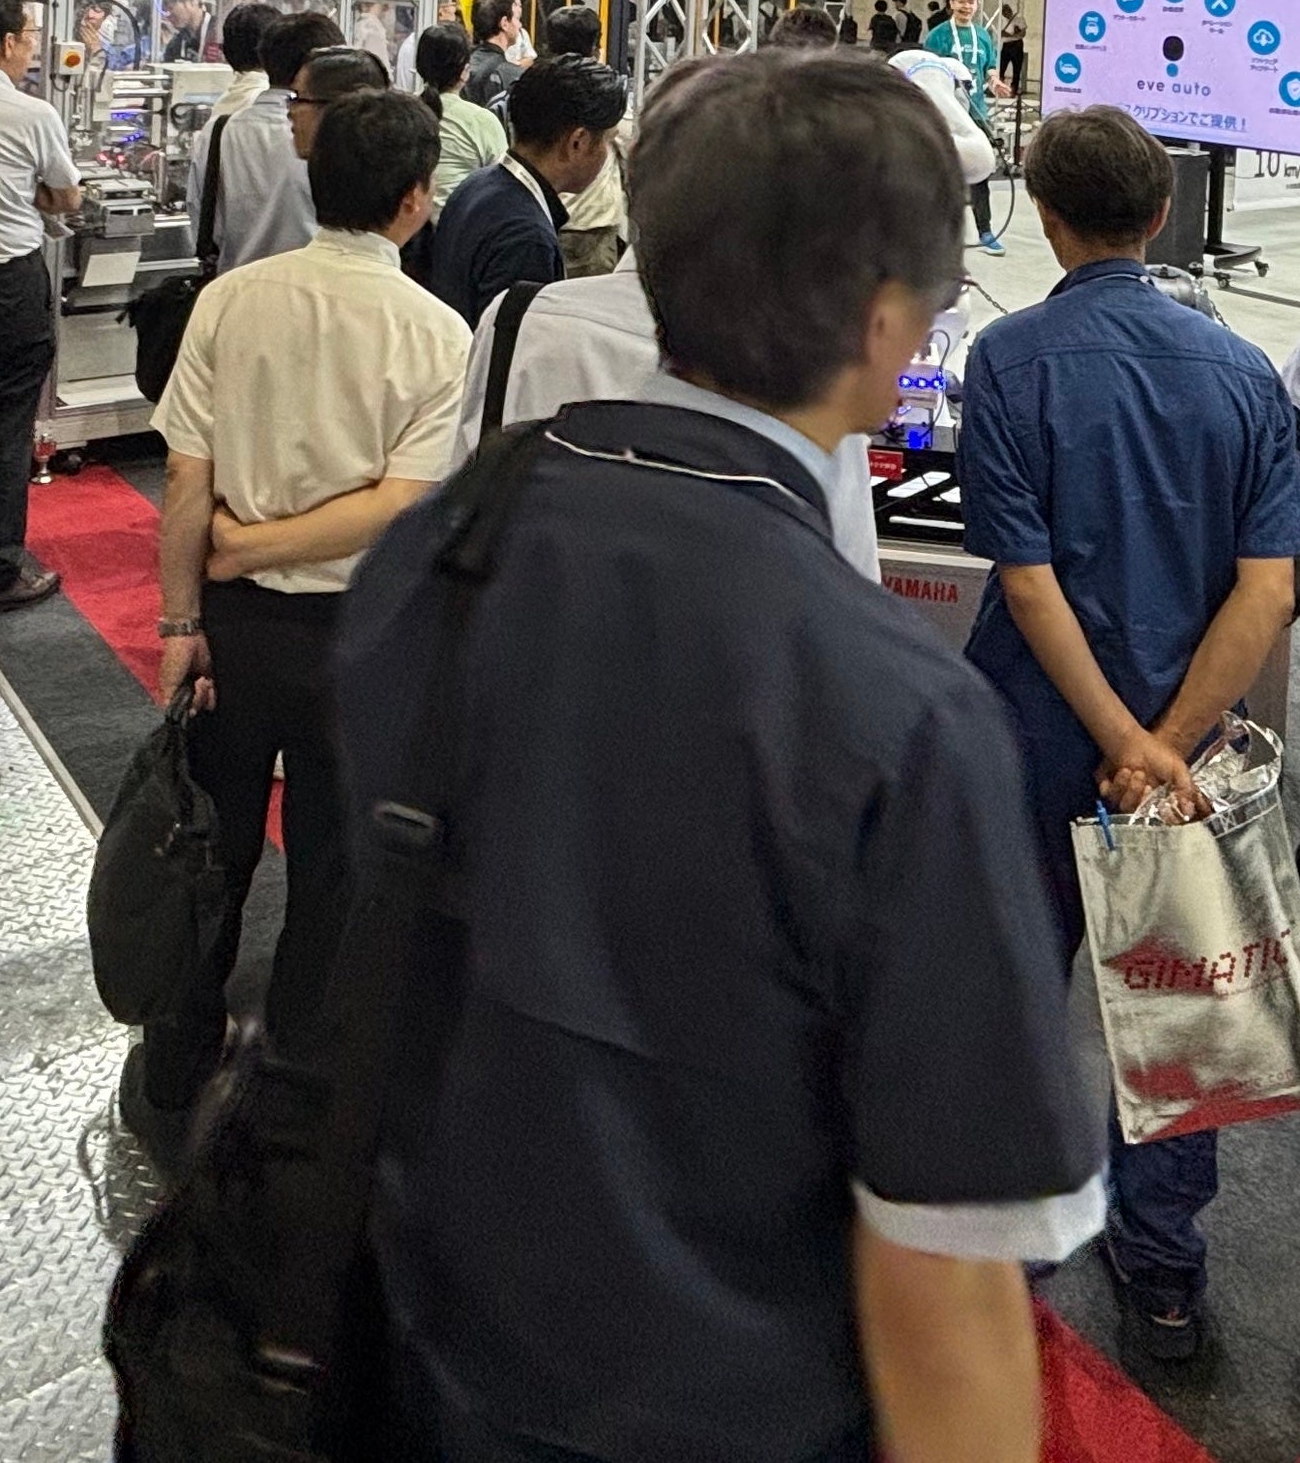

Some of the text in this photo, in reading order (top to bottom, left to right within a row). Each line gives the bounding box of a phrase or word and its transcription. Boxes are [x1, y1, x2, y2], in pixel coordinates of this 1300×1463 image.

[1137, 80, 1212, 97] eve auto
[882, 574, 959, 604] YAMAHA
